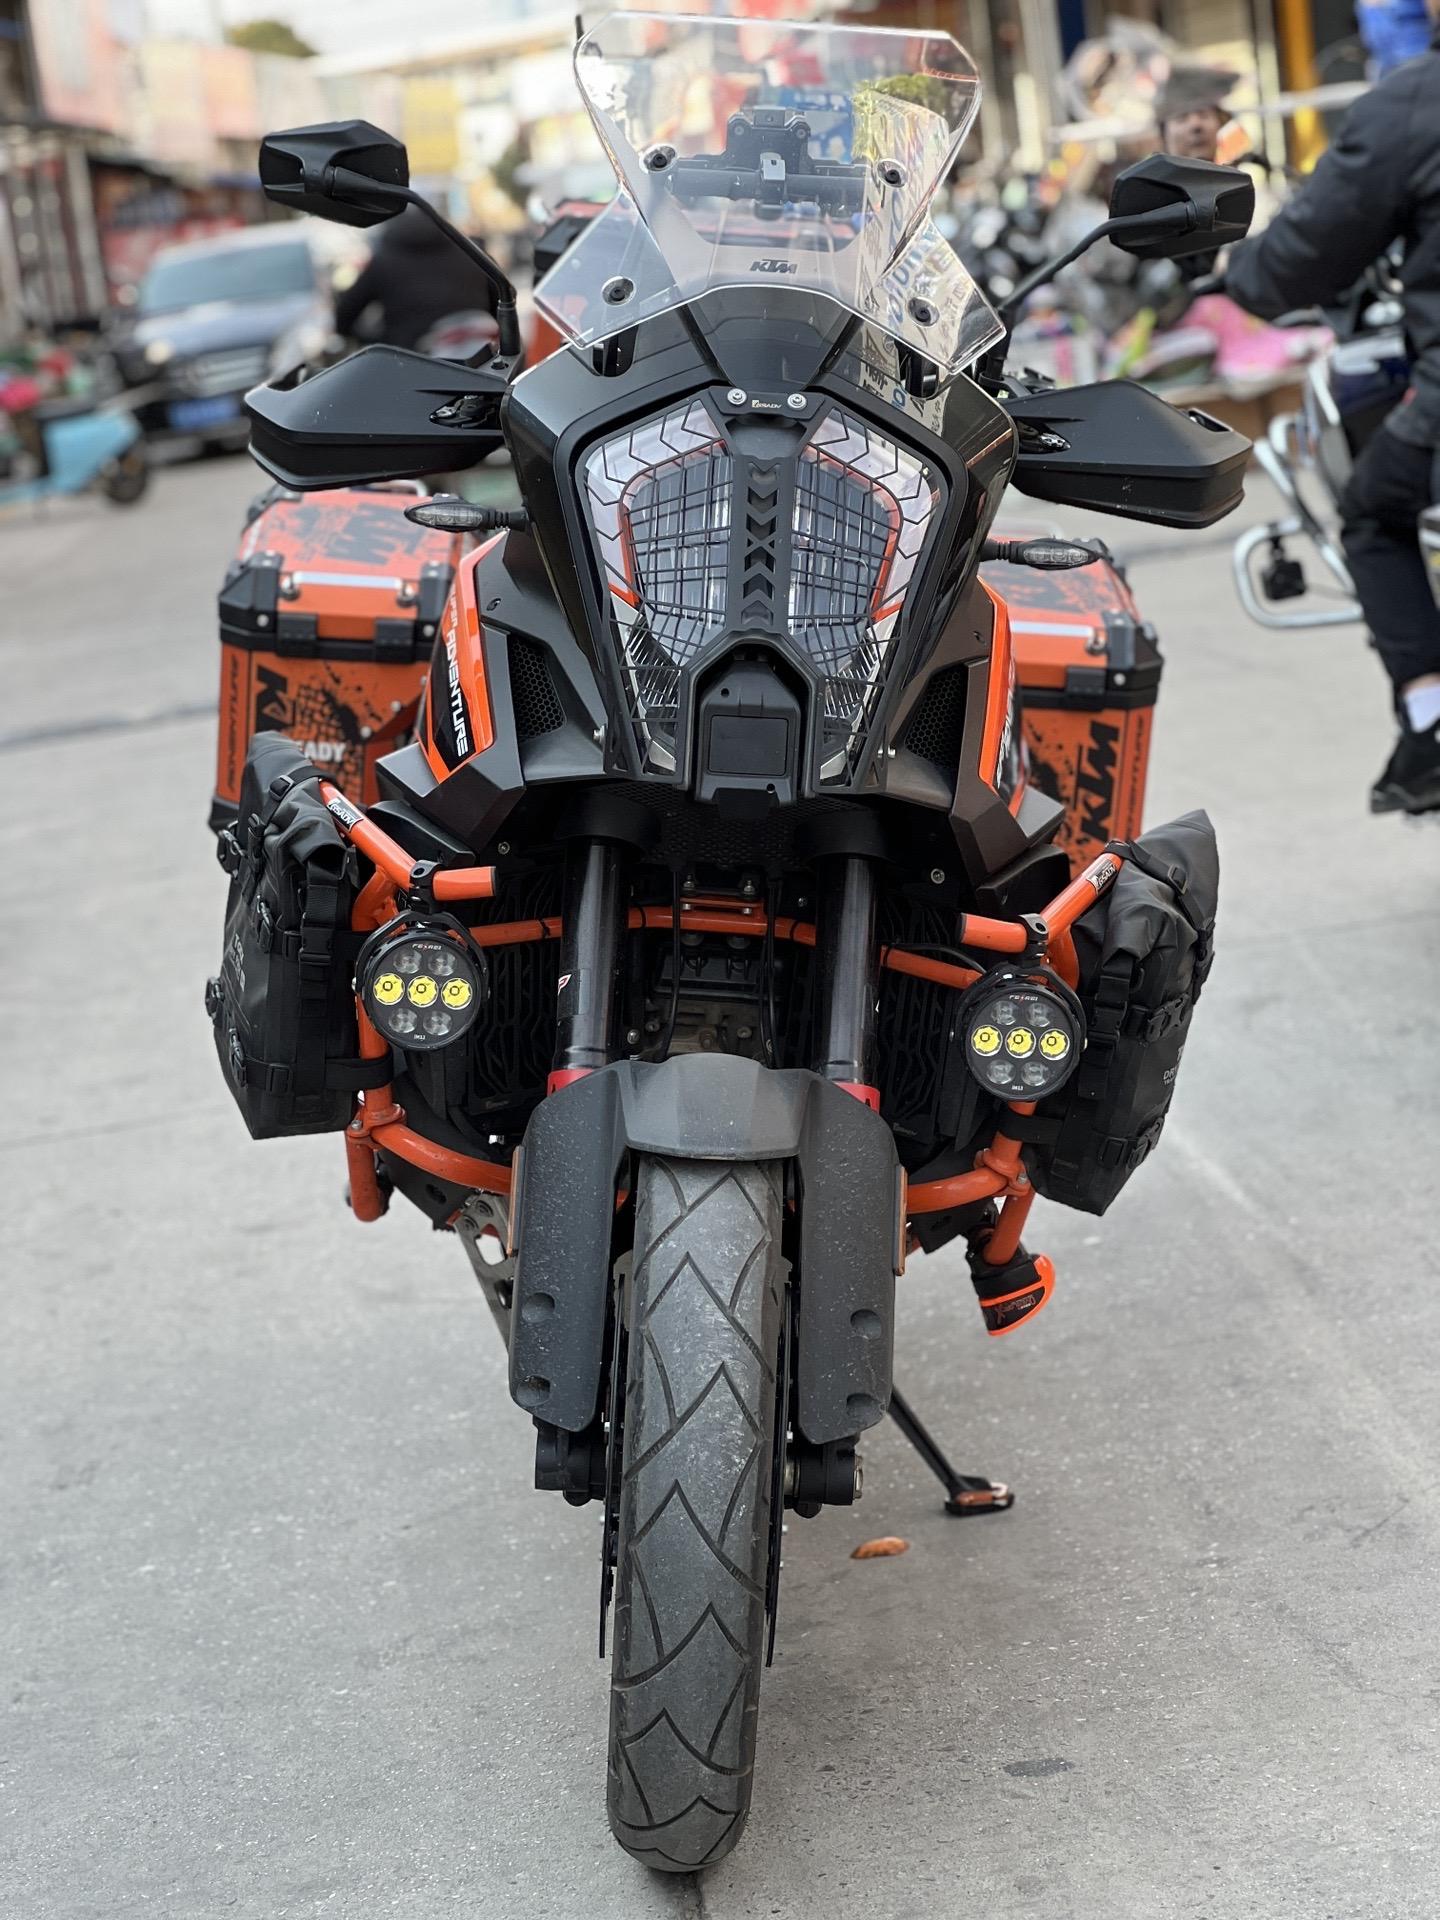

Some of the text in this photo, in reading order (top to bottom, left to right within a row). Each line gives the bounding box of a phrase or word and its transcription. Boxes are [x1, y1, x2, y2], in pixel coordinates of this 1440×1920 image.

[750, 259, 797, 274] KTM
[446, 629, 468, 757] ADVENTURE
[1073, 720, 1120, 843] KTM
